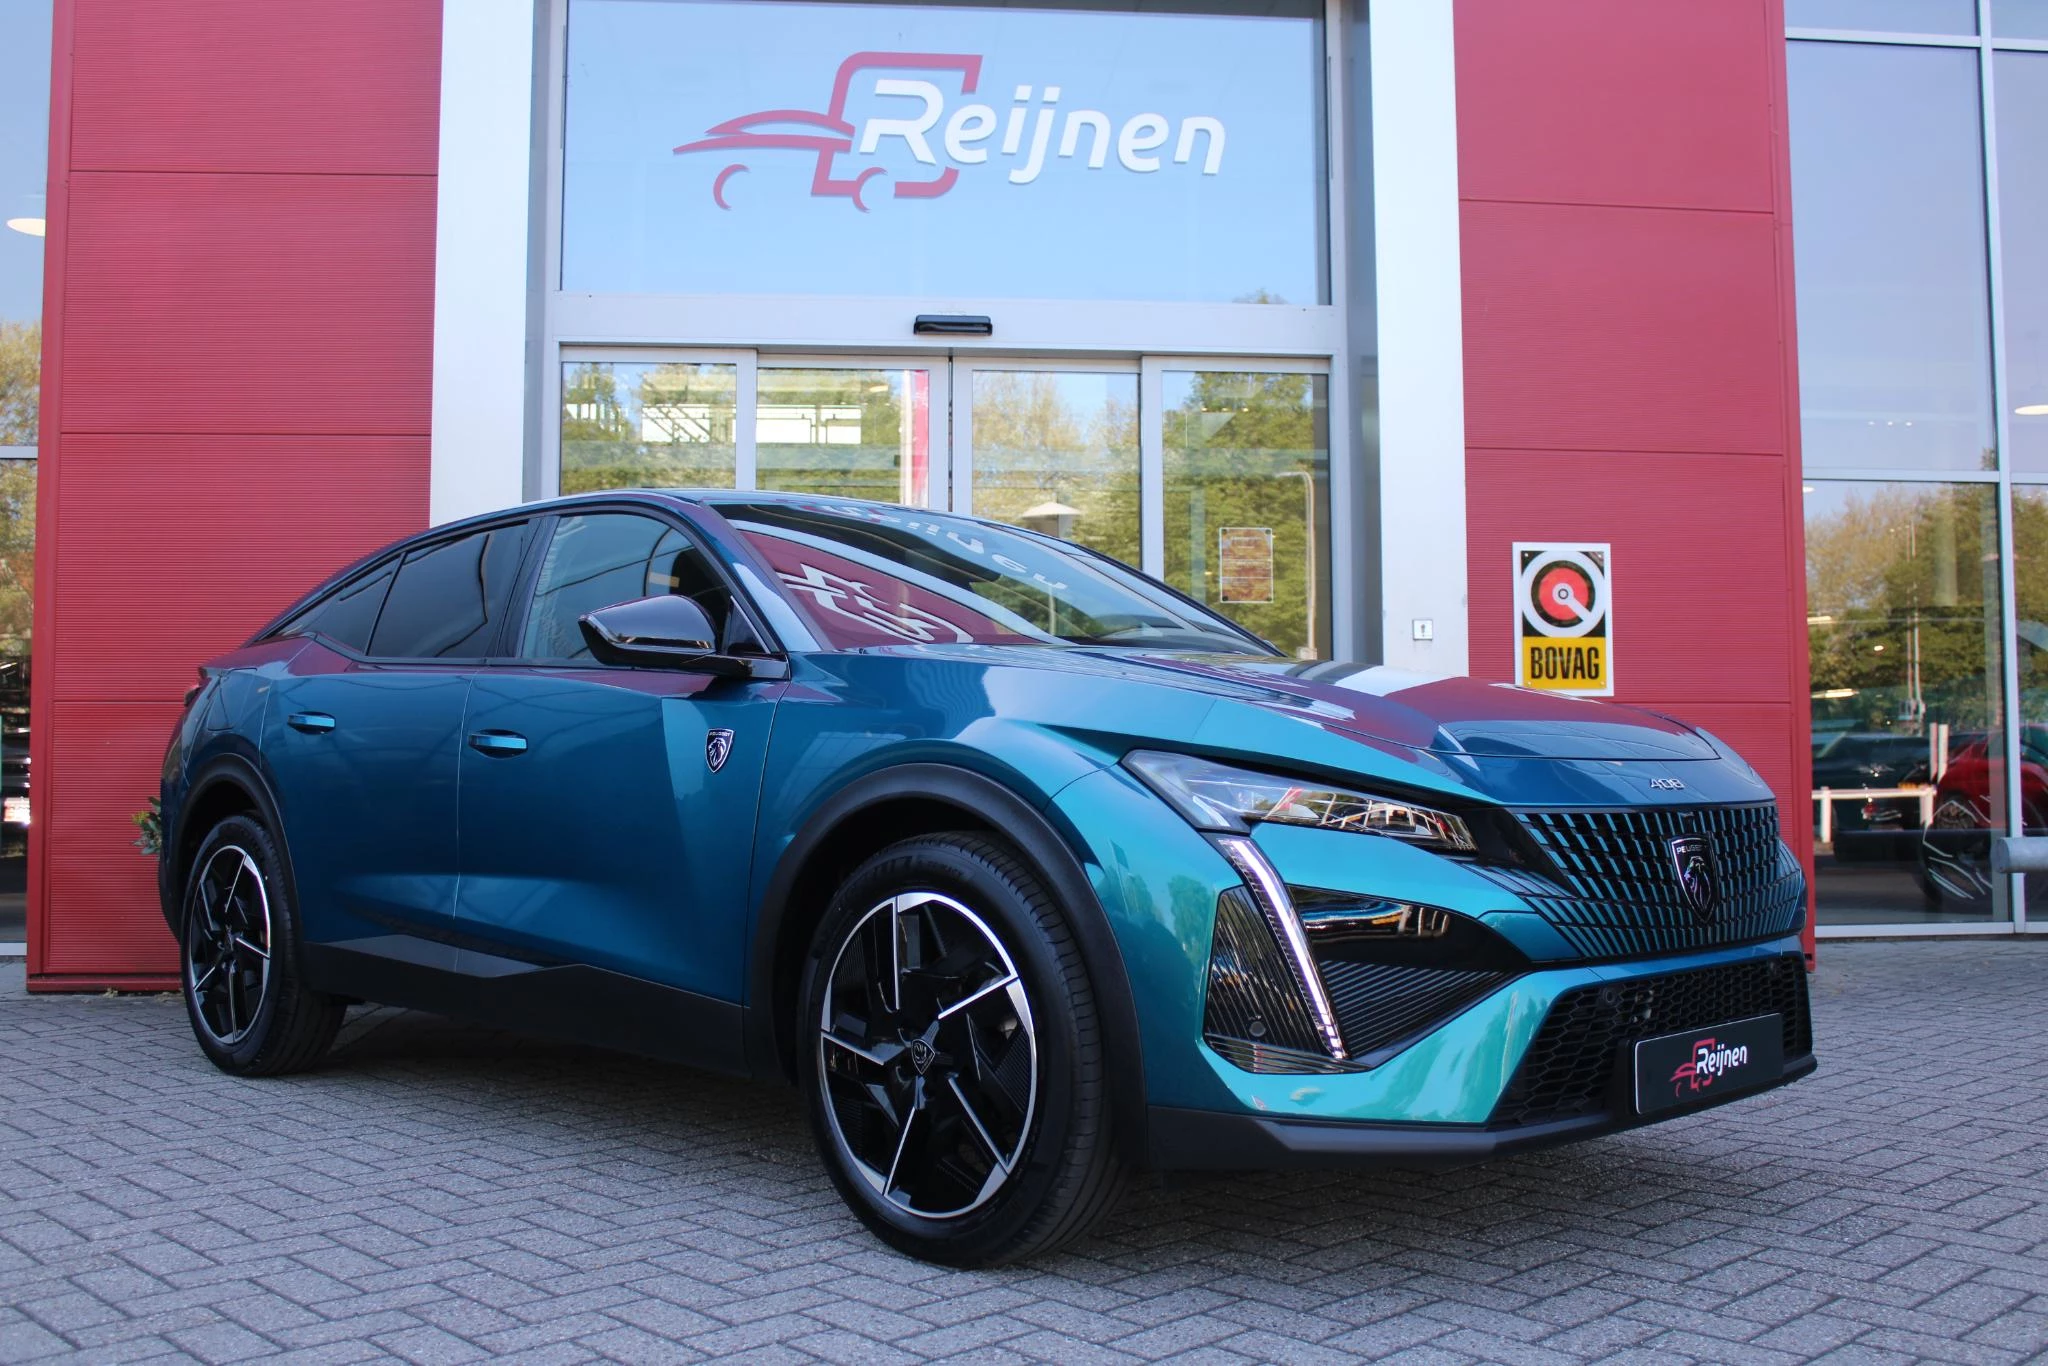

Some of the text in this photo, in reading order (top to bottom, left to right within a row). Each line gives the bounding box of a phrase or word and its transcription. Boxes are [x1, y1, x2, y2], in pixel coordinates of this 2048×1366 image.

[858, 79, 1226, 185] Reijnen
[1530, 646, 1600, 681] BOVAG
[1650, 778, 1685, 790] 408
[1696, 1043, 1748, 1076] Reijnen
